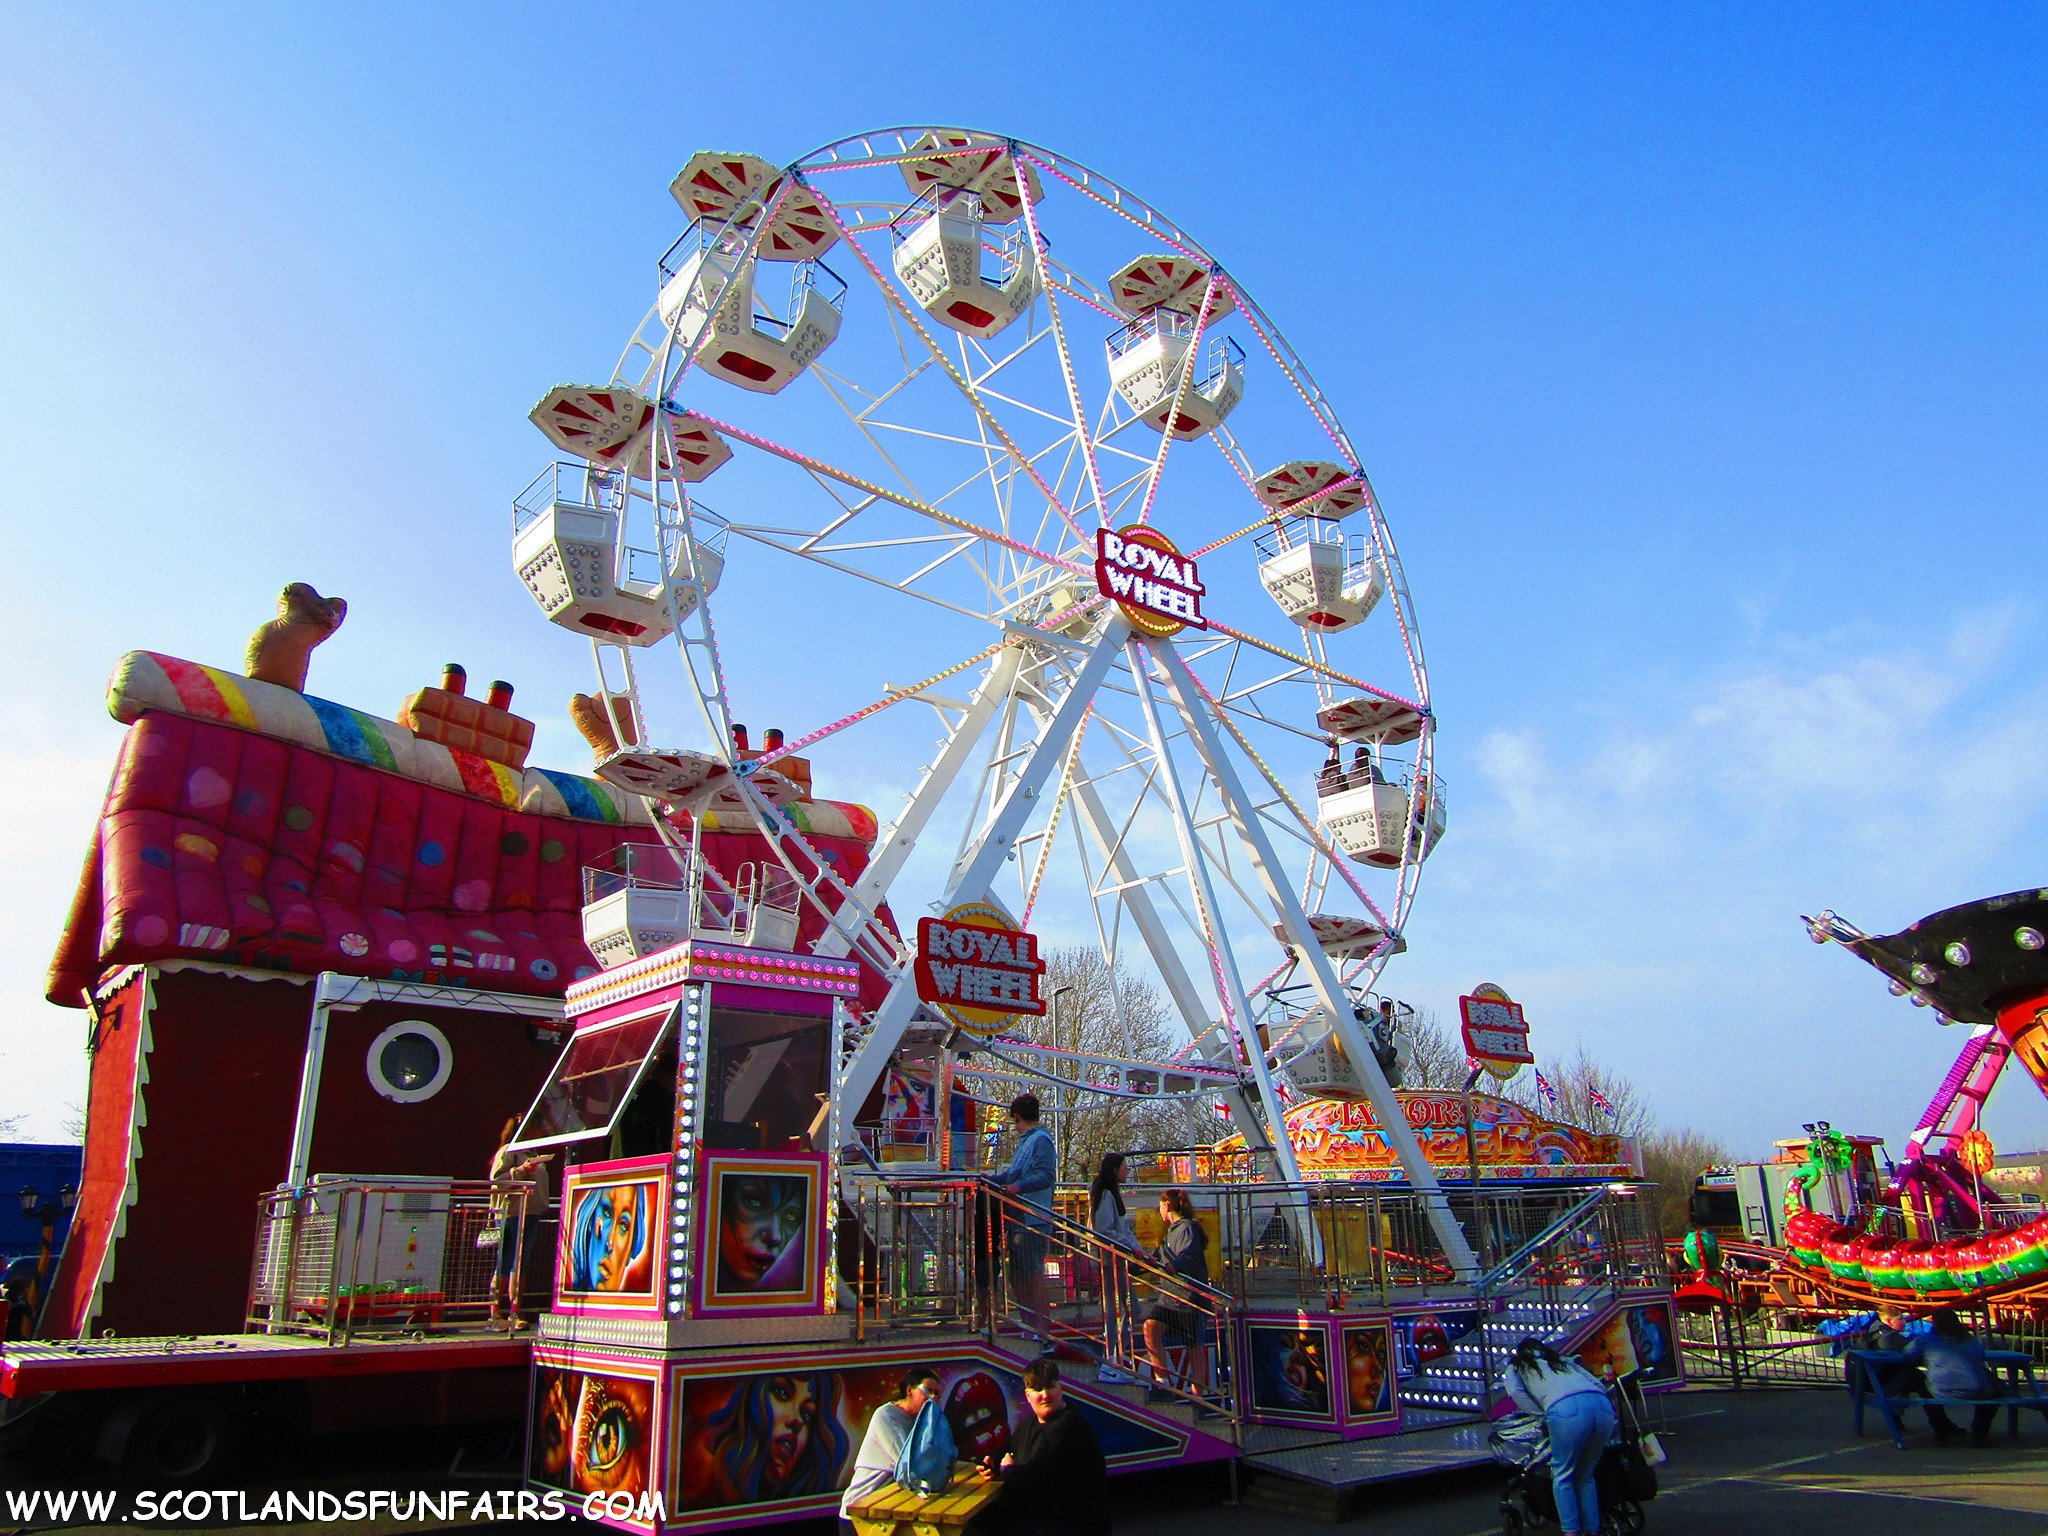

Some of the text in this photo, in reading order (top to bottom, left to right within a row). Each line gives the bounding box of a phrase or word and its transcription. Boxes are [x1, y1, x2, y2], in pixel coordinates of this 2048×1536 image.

[1103, 532, 1203, 592] ROYAL
[1103, 564, 1204, 624] WHEEL
[928, 922, 1038, 970] ROYAL
[927, 960, 1041, 1010] WHEEL
[1287, 1121, 1535, 1160] WALZER
